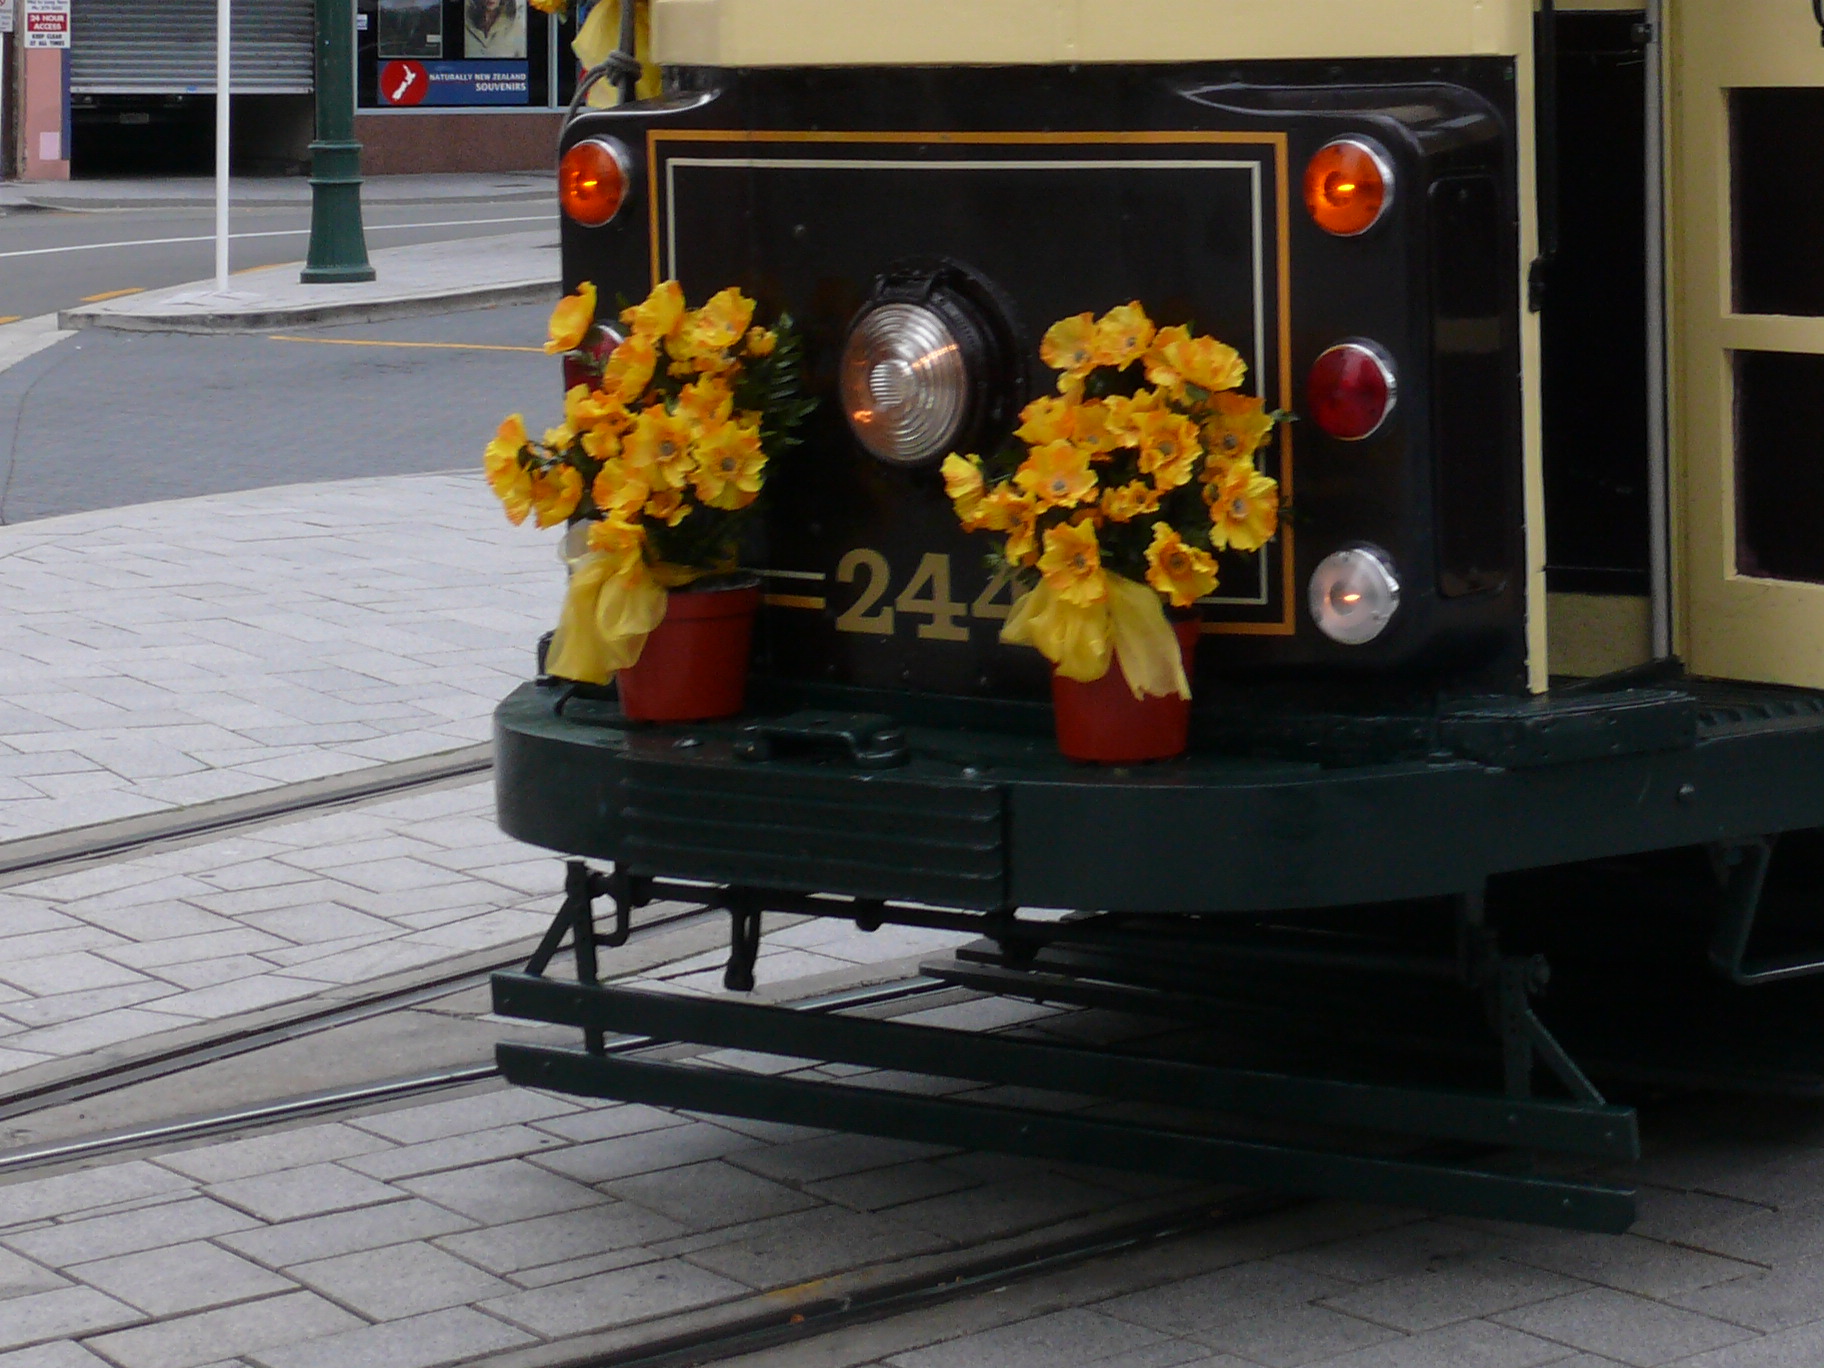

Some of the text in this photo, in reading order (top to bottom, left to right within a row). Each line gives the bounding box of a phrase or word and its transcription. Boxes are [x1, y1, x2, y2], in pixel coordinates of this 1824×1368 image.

[42, 14, 65, 22] HOUR
[33, 22, 62, 30] ACCESS
[428, 73, 527, 82] NATURALLY NEW ZEALAND
[475, 82, 527, 92] SOUVENIRS
